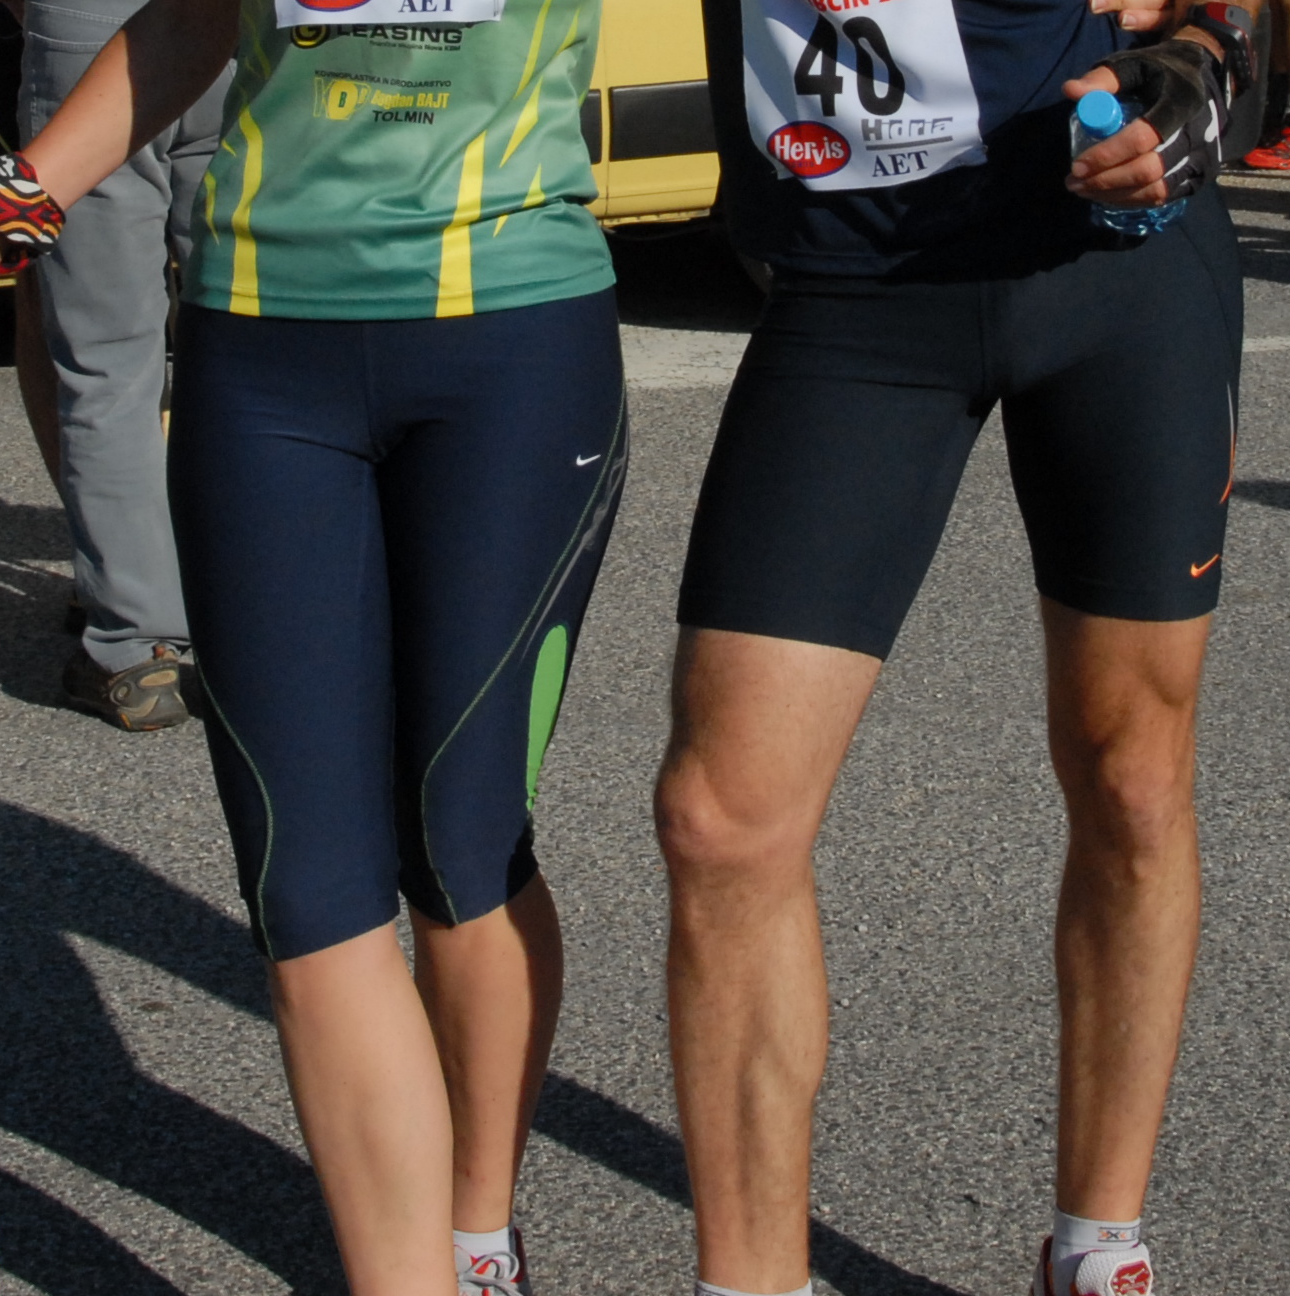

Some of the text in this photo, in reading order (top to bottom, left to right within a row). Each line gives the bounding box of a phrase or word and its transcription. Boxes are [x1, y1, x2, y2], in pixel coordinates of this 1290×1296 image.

[337, 24, 462, 44] LEASING
[794, 13, 905, 118] 40
[372, 110, 435, 125] TOLMIN
[774, 132, 845, 165] Hervis
[872, 150, 929, 178] AET
